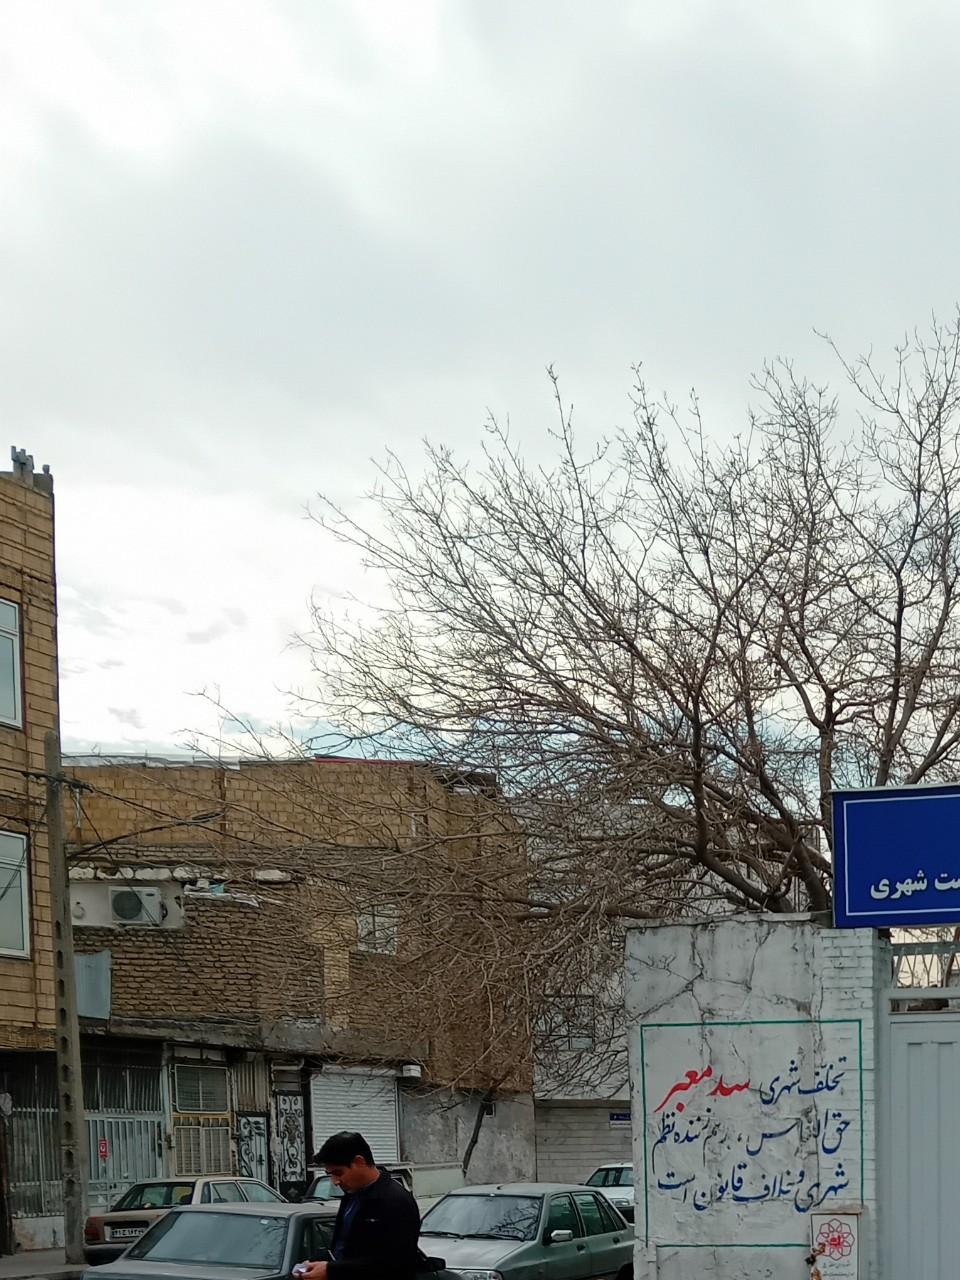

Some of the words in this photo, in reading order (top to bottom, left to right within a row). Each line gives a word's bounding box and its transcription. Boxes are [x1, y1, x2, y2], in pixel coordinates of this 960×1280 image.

[869, 870, 927, 900] شهری
[653, 1065, 713, 1113] معبر
[706, 1074, 751, 1097] سد
[759, 1060, 800, 1105] شهری
[657, 1171, 696, 1203] است
[794, 1163, 850, 1213] شهری
